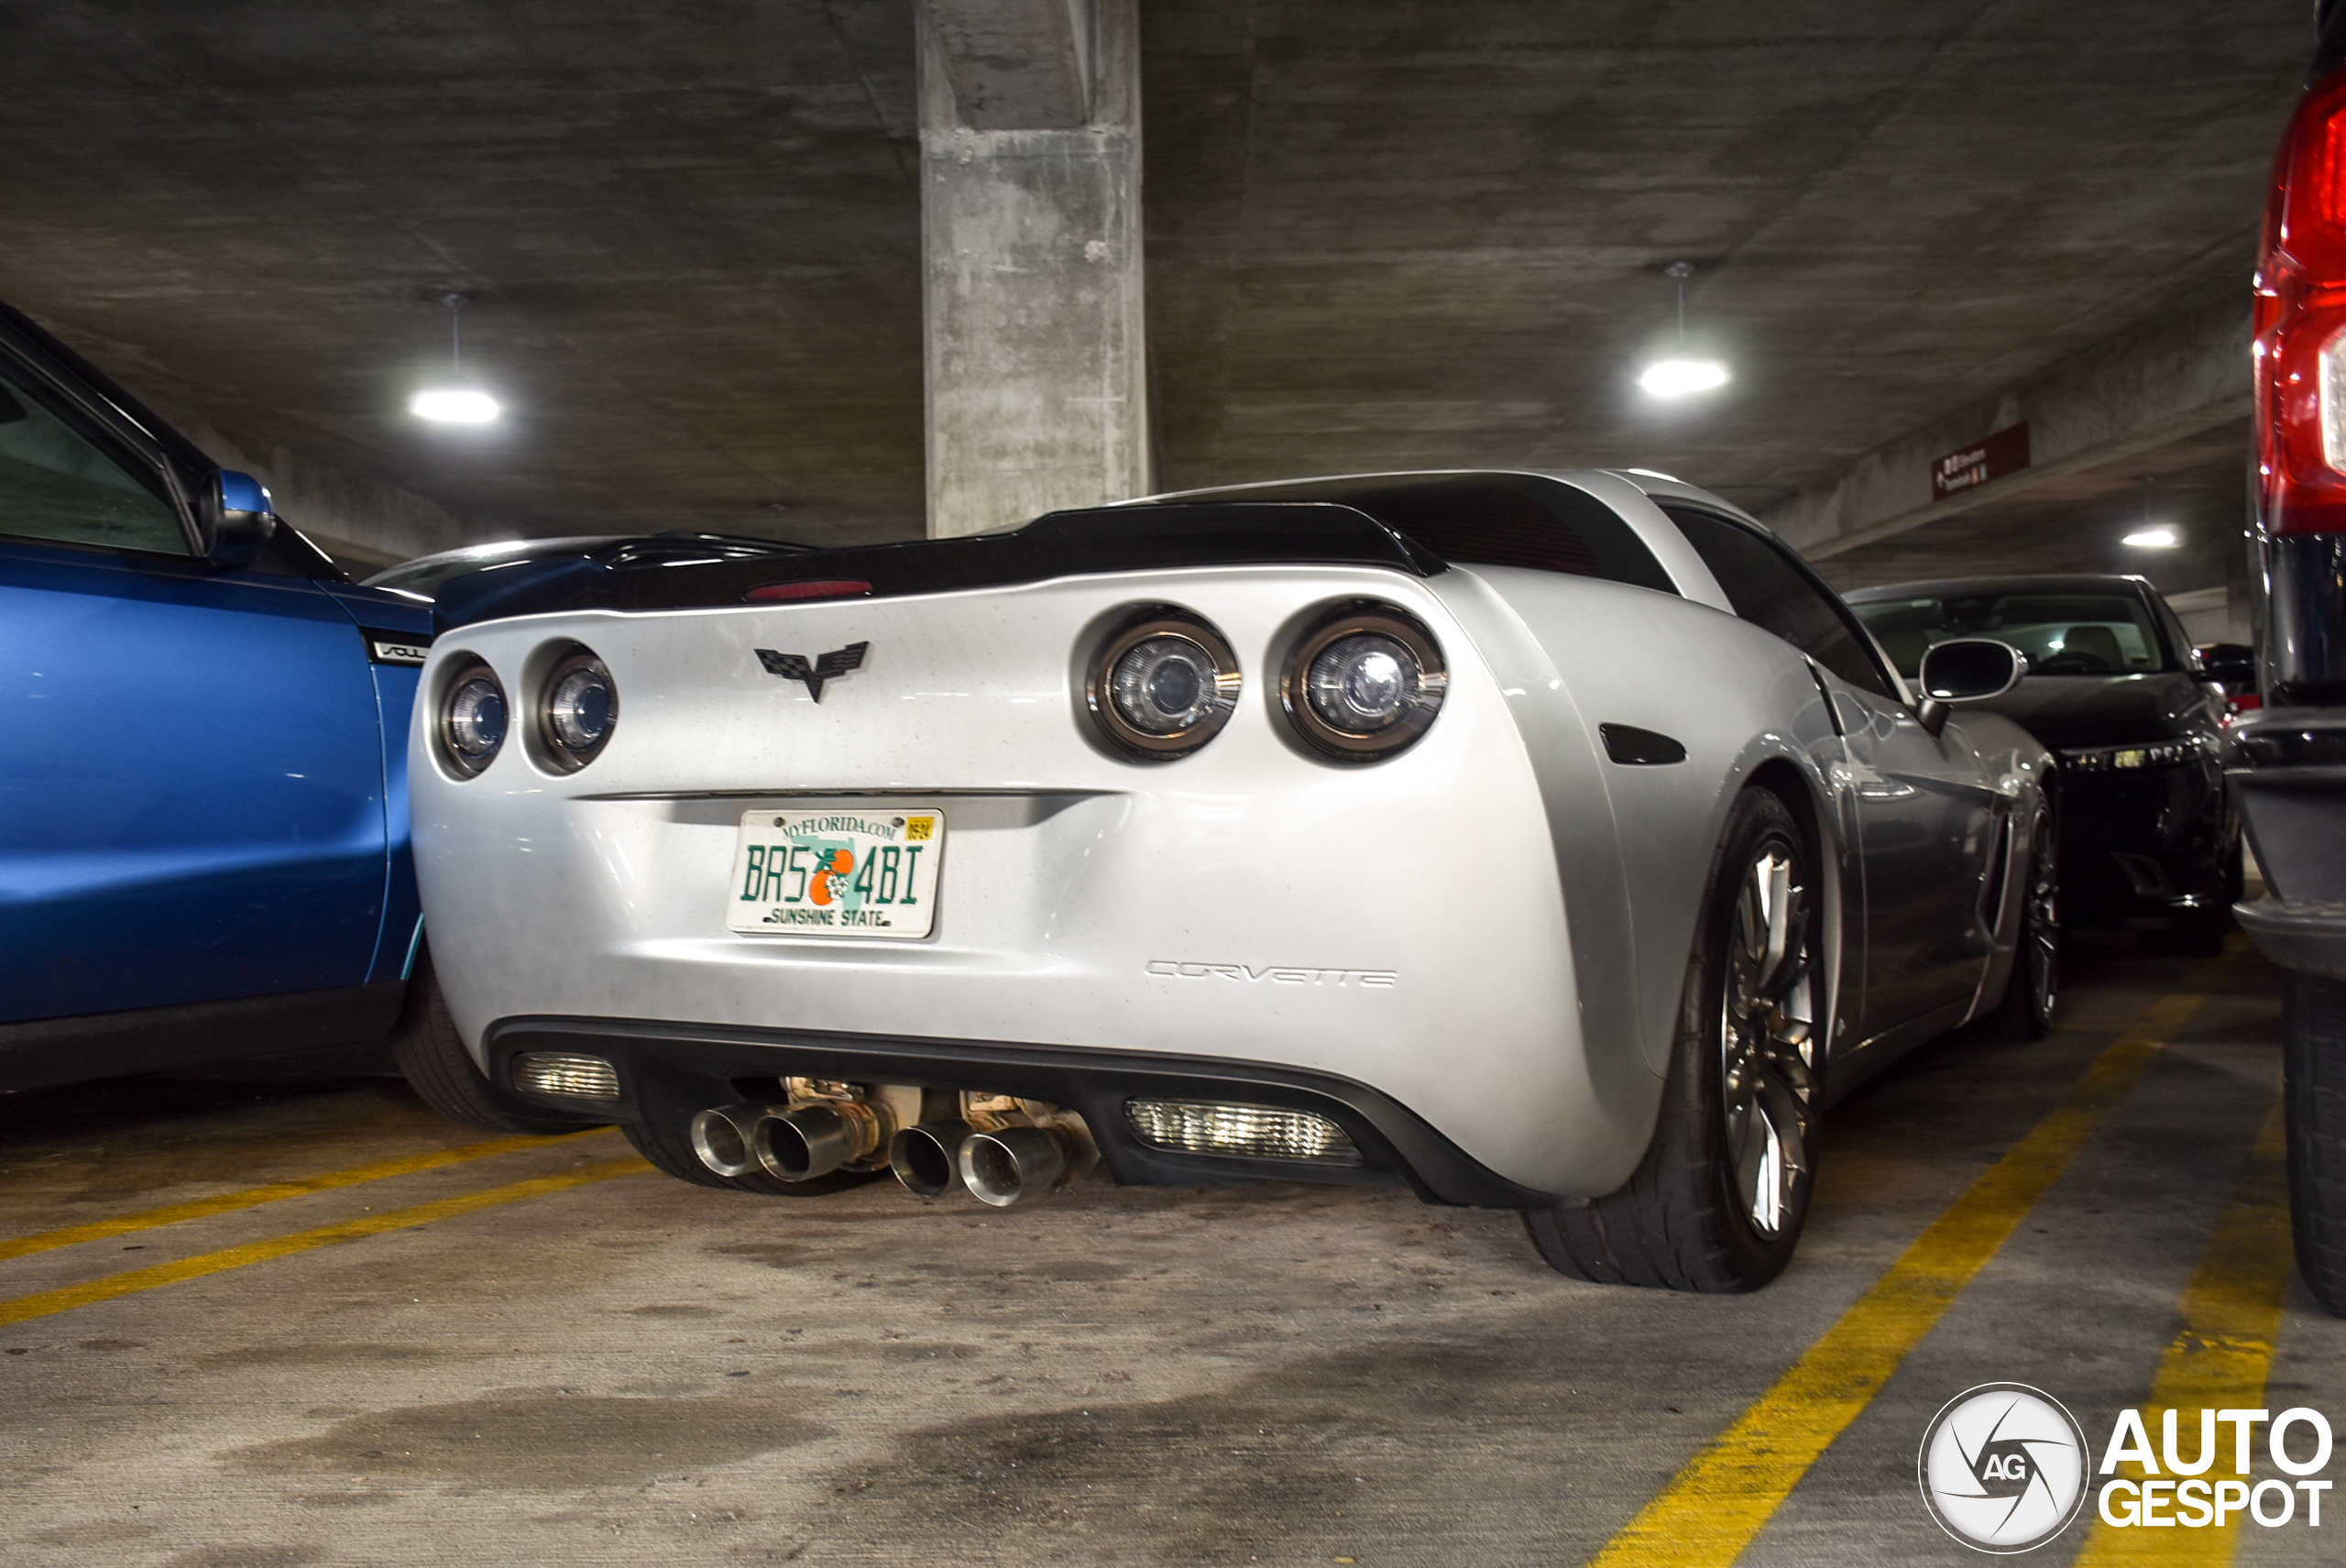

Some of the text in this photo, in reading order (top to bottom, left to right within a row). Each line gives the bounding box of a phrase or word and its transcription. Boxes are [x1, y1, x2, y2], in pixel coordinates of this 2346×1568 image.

[783, 817, 897, 841] MYFLORIDA.COM
[740, 844, 924, 905] BR5 4BI
[771, 907, 883, 927] SUNSHINE STATE
[1145, 959, 1398, 989] CORVETTE
